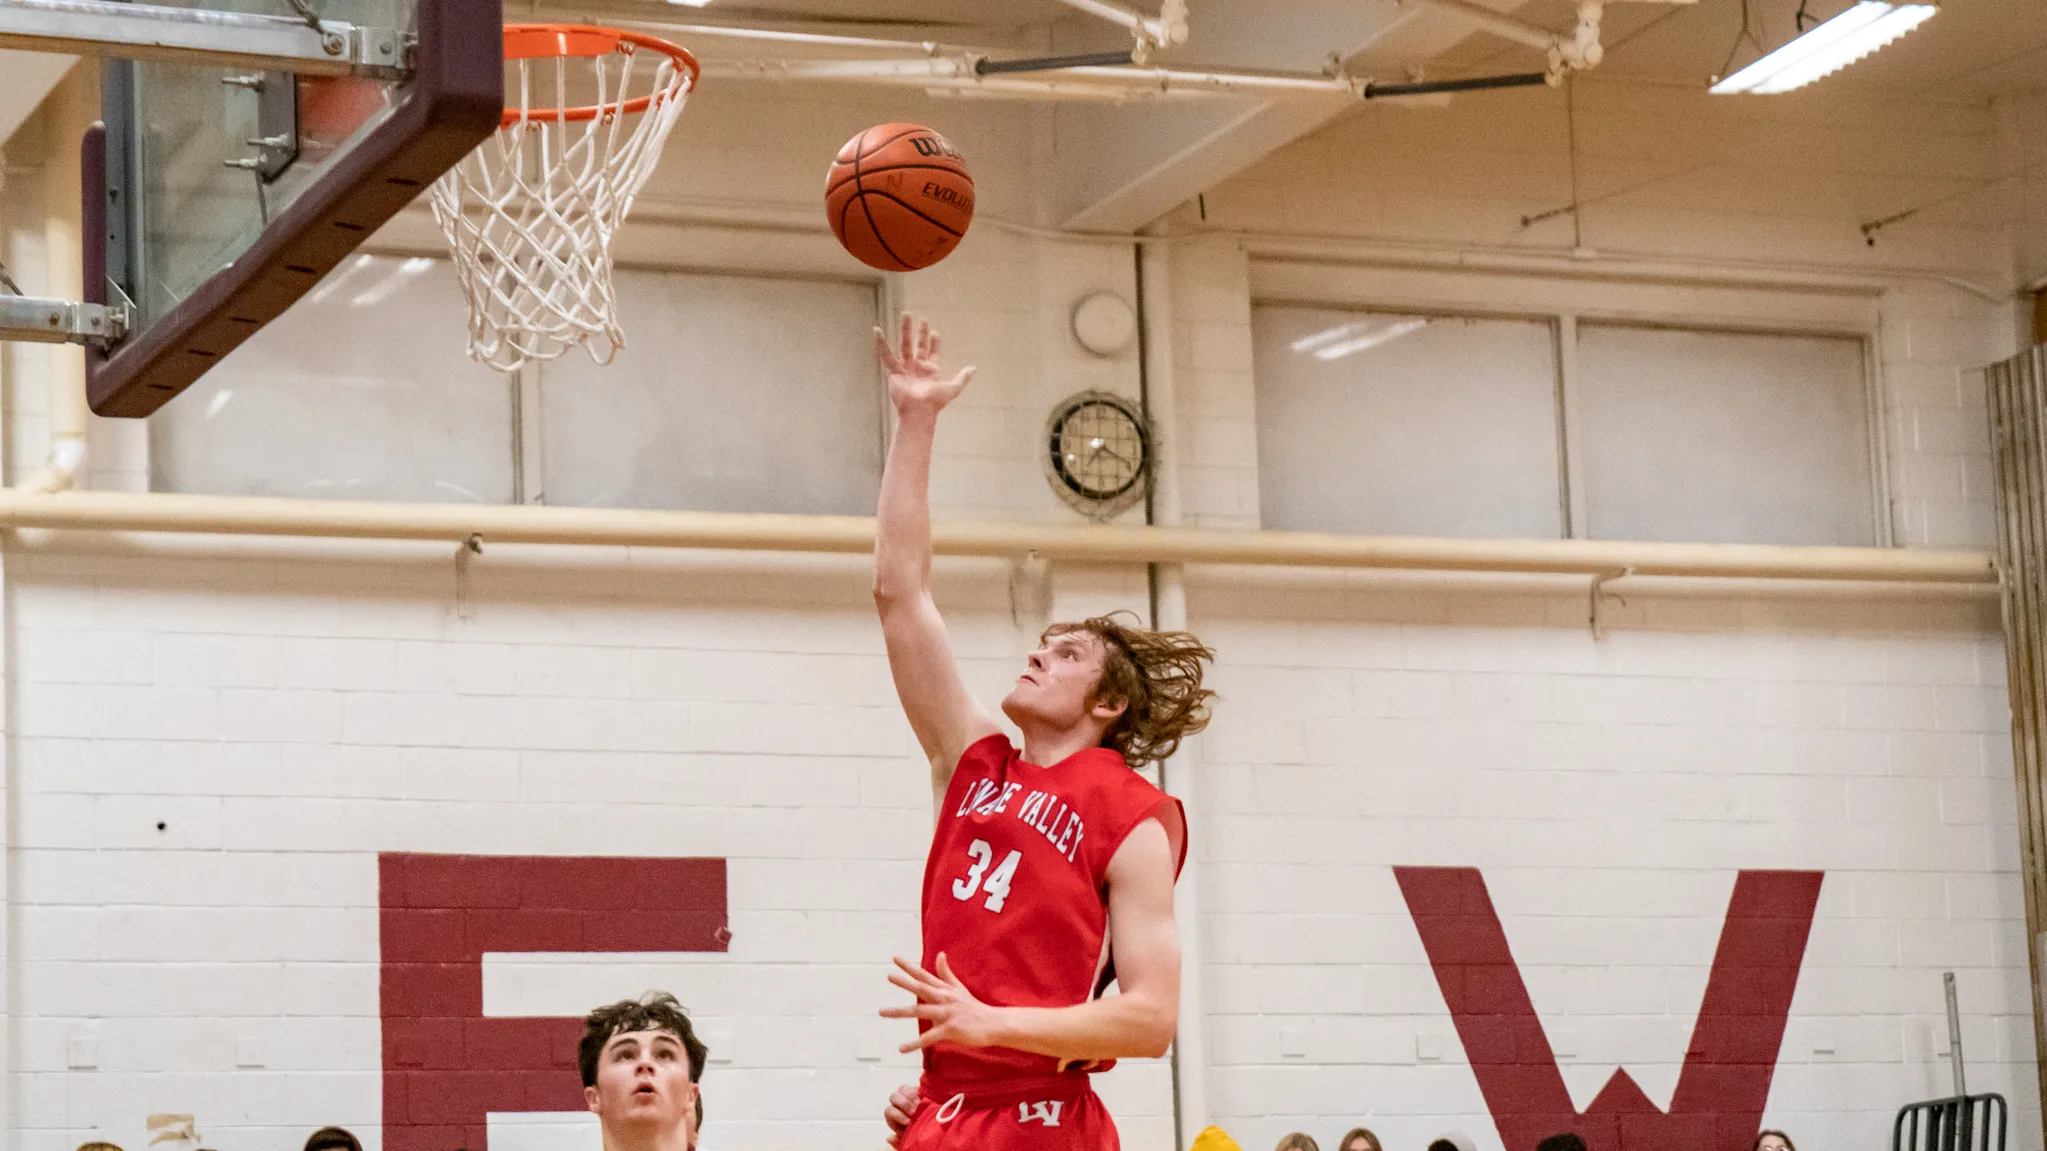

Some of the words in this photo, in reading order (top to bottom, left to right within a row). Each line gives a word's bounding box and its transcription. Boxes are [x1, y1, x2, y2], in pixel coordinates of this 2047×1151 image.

[1017, 790, 1083, 863] VALLEY
[952, 838, 1022, 913] 34
[1392, 865, 1825, 1151] W
